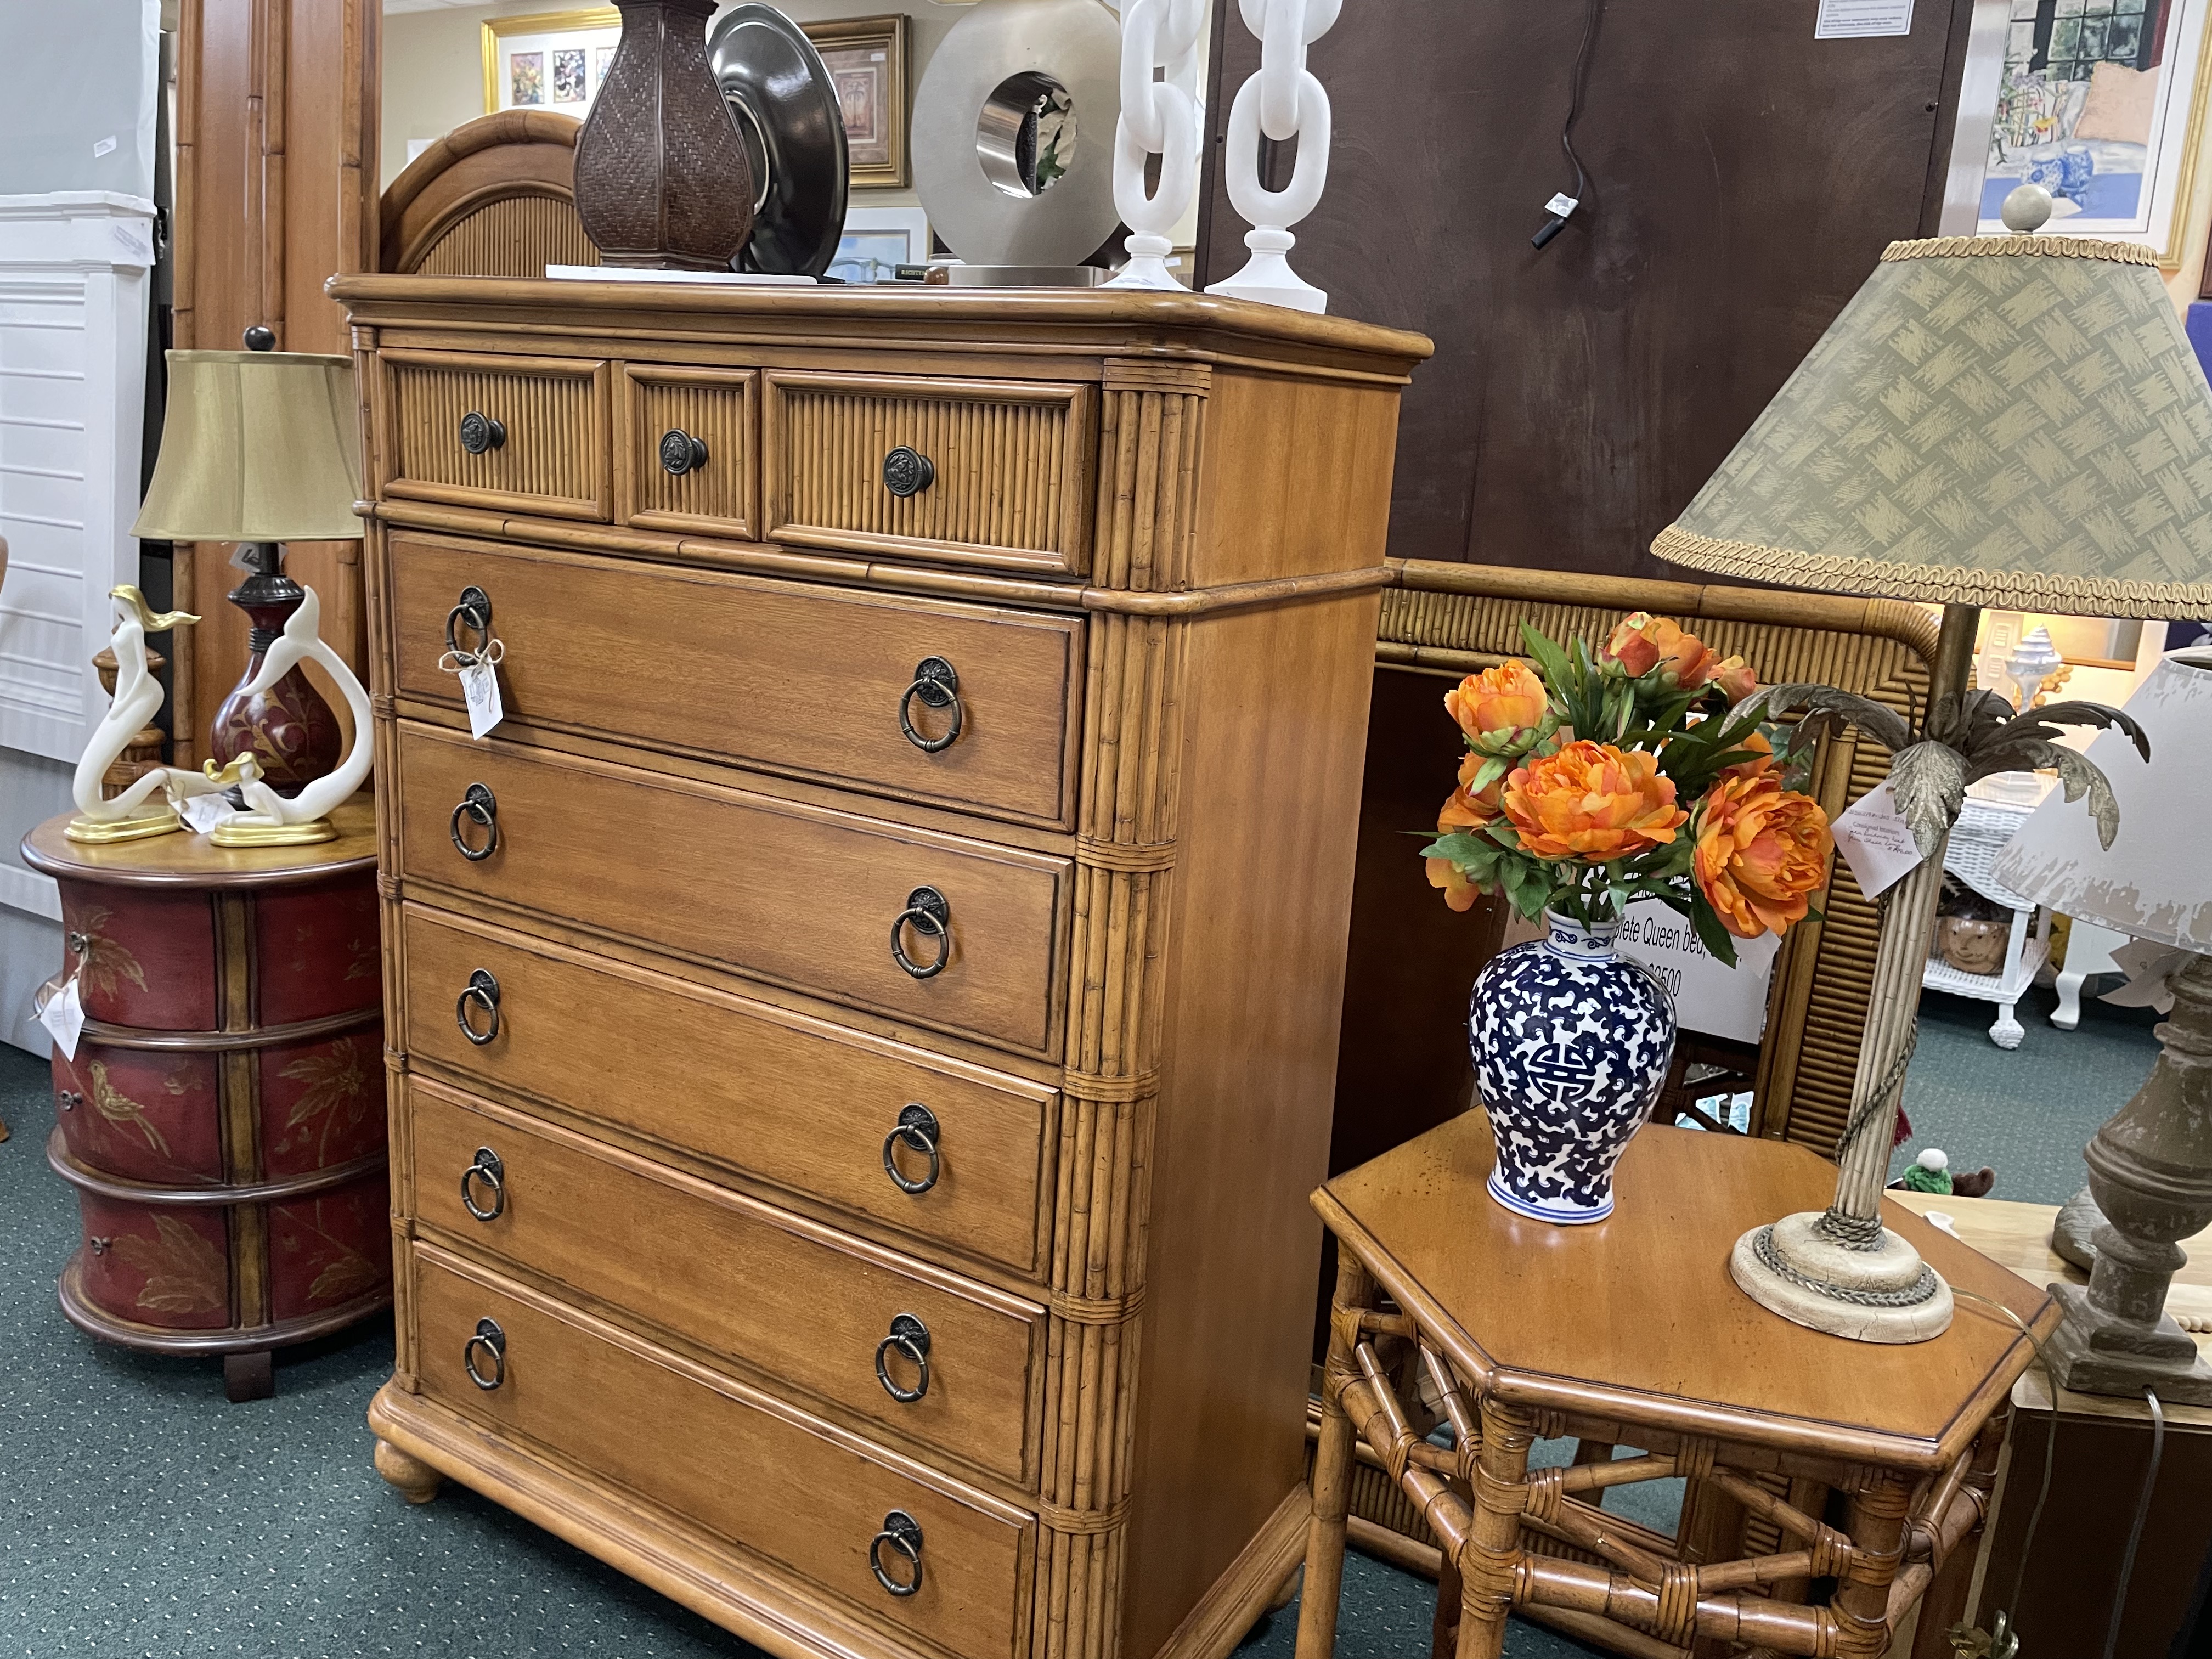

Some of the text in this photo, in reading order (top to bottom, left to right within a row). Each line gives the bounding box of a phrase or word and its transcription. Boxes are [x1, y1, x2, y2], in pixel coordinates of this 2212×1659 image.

[1615, 916, 1640, 943] lete
[1643, 917, 1680, 950] Queen
[1649, 962, 1681, 997] 500
